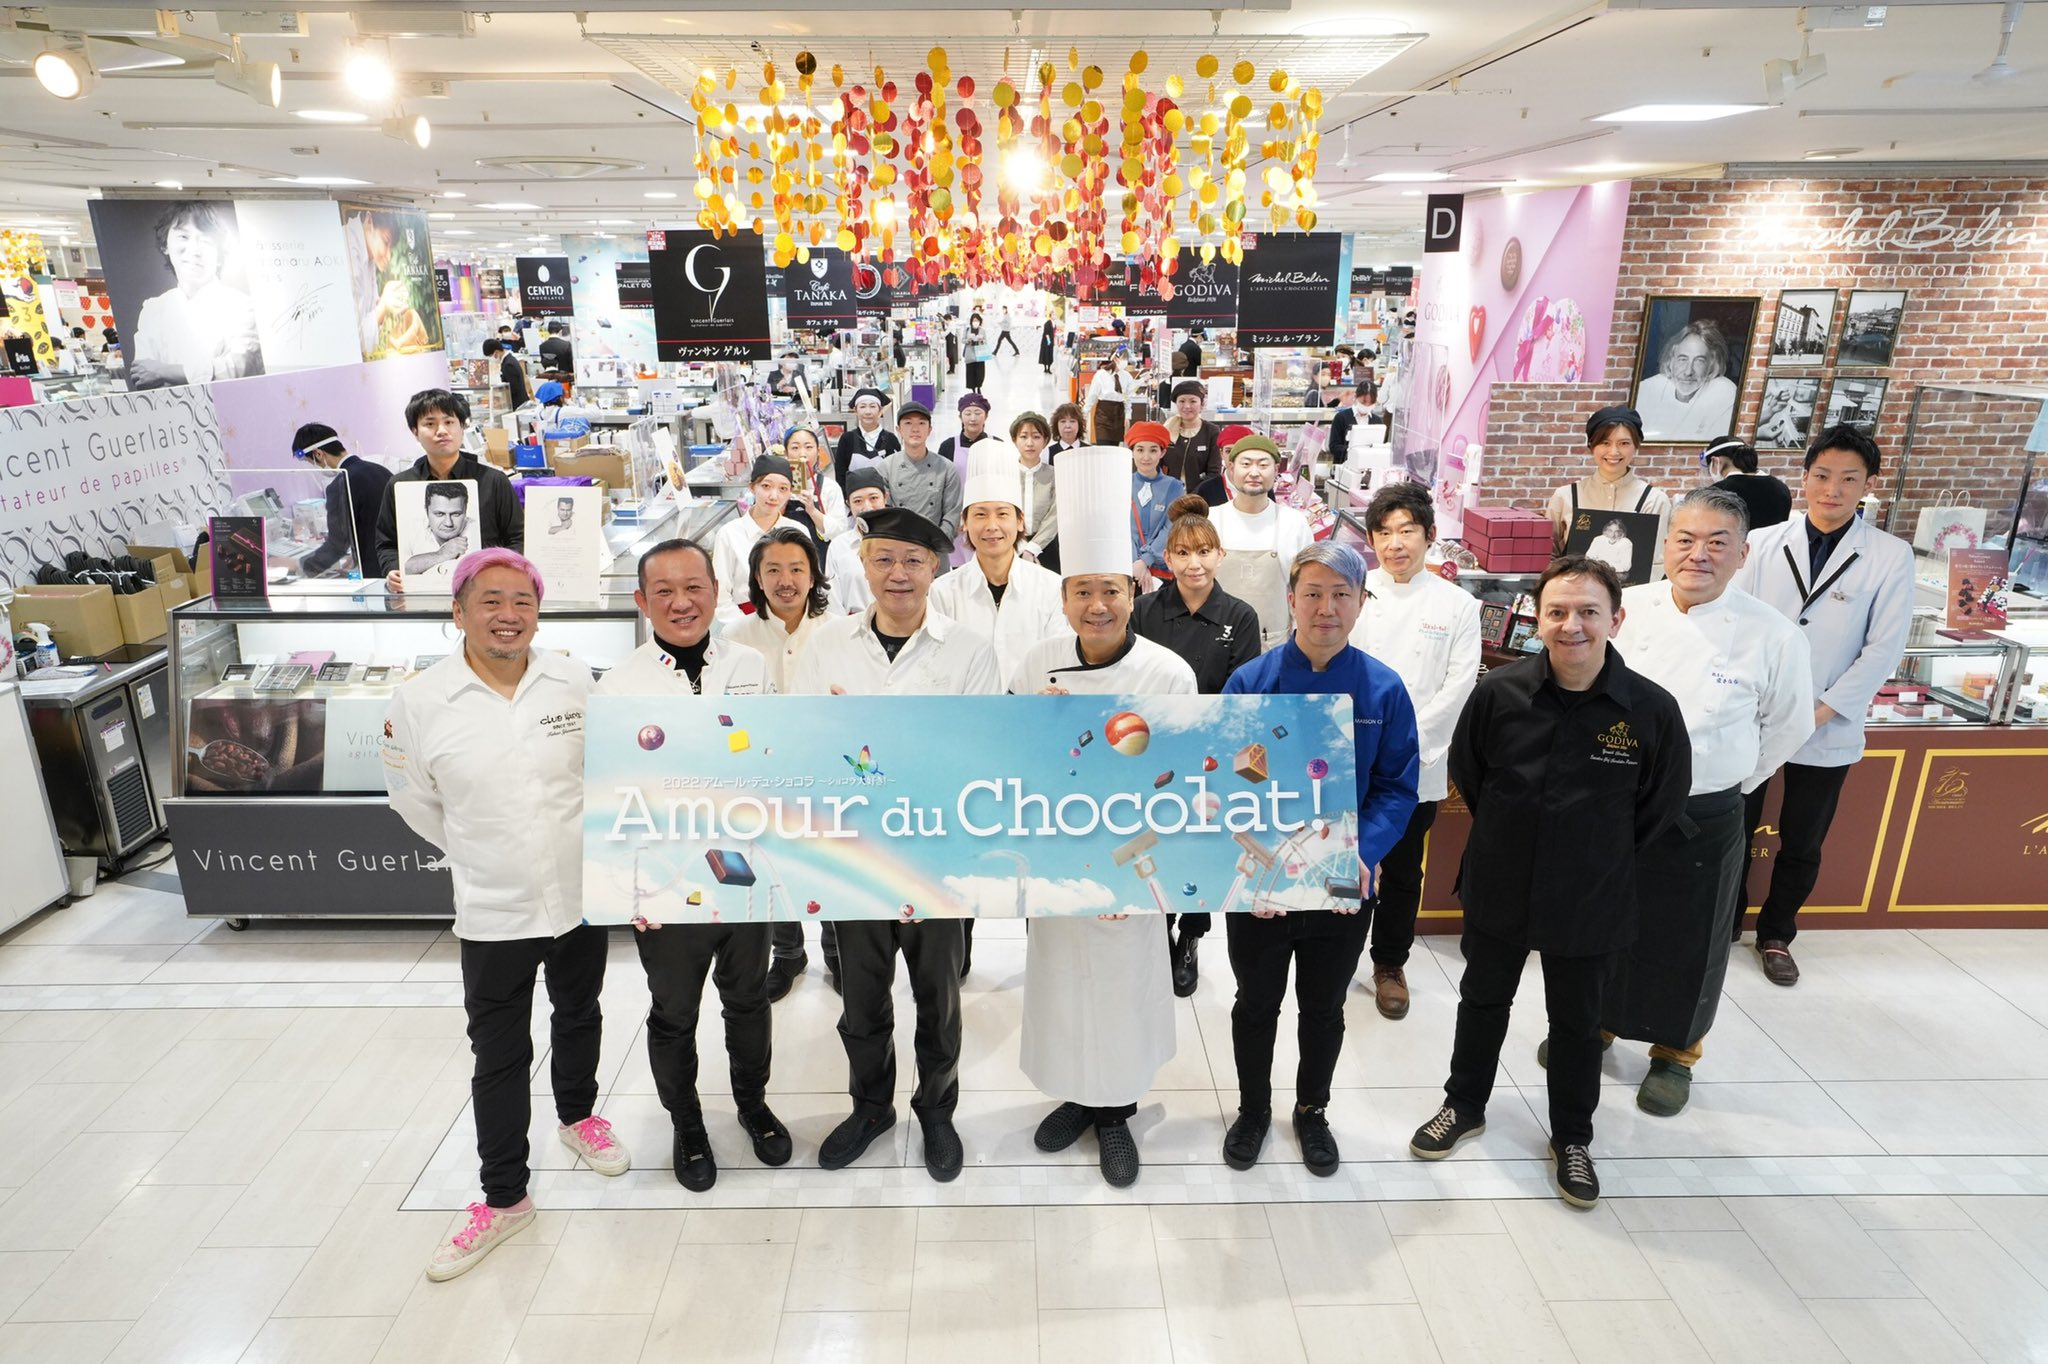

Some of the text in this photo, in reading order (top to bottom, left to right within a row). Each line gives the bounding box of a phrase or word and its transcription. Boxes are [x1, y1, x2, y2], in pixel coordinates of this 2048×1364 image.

[1431, 207, 1457, 239] D
[1292, 271, 1330, 284] Belin
[527, 285, 565, 296] CENTHO
[793, 289, 848, 301] TANAKA
[1173, 284, 1232, 297] GODIVA
[1190, 318, 1213, 326] ゴディバ
[1252, 334, 1321, 343] ミッシェル・ブラン
[678, 345, 751, 358] ヴァンサン ゲルレ
[0, 420, 189, 481] cent Guerlais
[80, 475, 101, 495] de
[1597, 733, 1639, 748] GODIVA
[662, 776, 701, 789] 2022
[603, 775, 1326, 842] Amour du Chocolat!
[192, 849, 318, 872] Vincent
